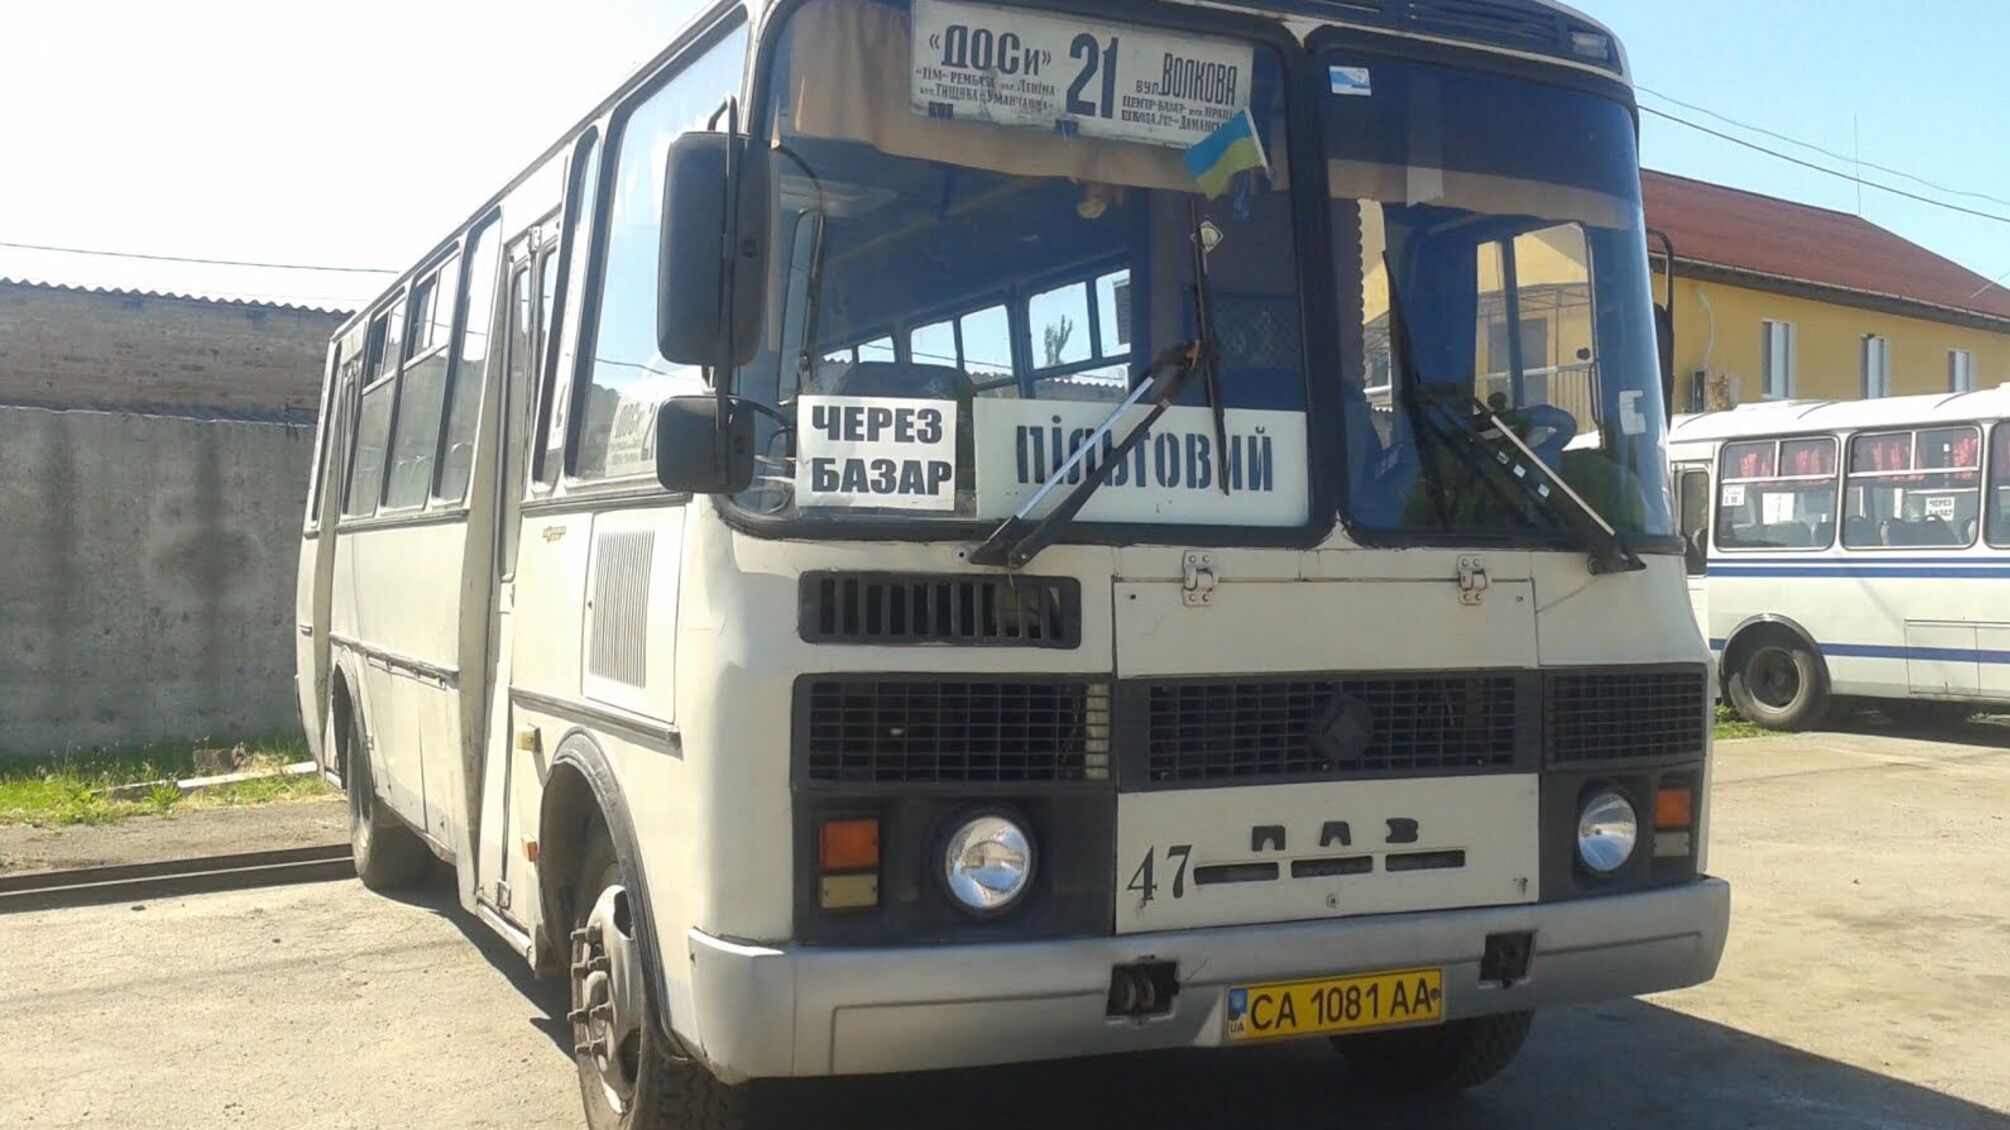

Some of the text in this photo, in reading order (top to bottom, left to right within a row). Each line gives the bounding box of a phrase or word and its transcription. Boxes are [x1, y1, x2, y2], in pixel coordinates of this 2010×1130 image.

[1066, 33, 1119, 119] 21
[812, 406, 942, 443] ЧЕРЕЗ
[811, 457, 952, 495] БАЗАР
[1126, 844, 1193, 901] 47
[1310, 982, 1379, 1025] 1081
[1390, 977, 1432, 1015] AA
